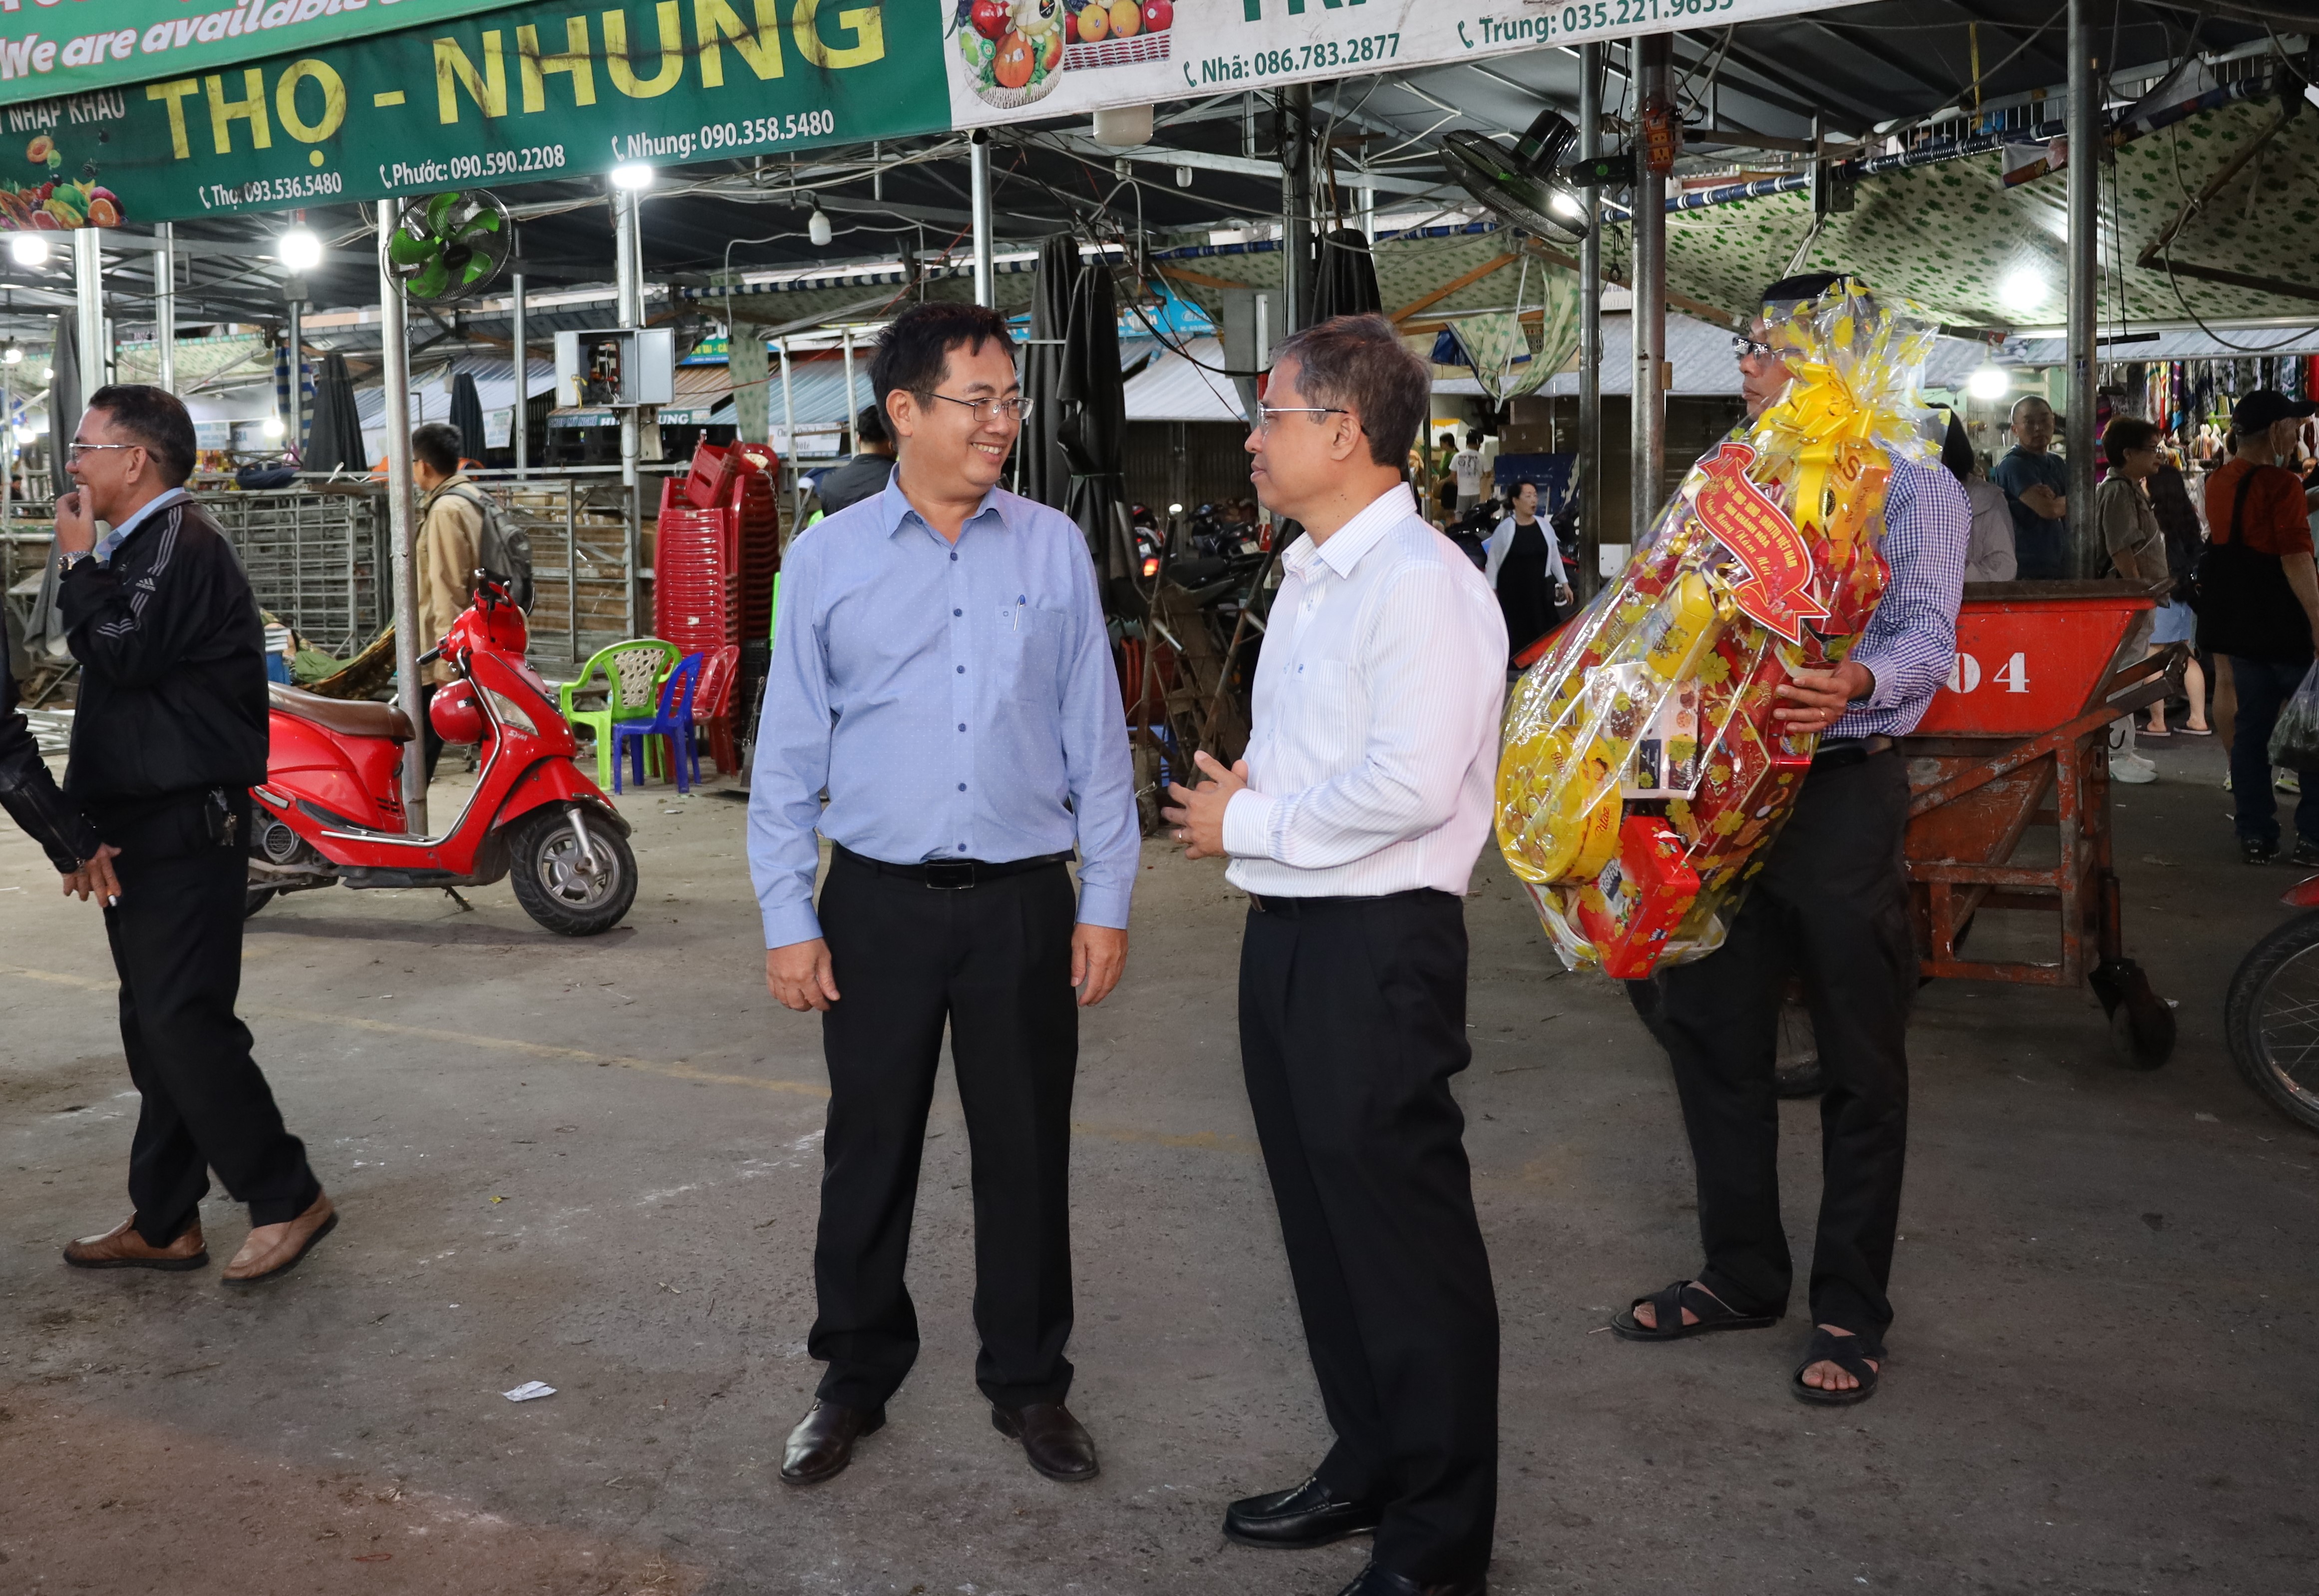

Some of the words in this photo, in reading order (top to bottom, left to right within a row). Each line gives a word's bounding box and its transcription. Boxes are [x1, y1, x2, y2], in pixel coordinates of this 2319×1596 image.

[1479, 15, 1557, 44] Trung:
[0, 33, 57, 80] We
[61, 27, 138, 67] are
[1202, 54, 1249, 83] Nhã:
[1255, 33, 1400, 75] 086.783.2877
[145, 58, 346, 168] THỌ
[432, 0, 886, 125] NHUNG
[627, 132, 697, 159] Nhung:
[700, 109, 834, 150] 090.358.5480
[392, 159, 448, 186] Phước:
[450, 144, 566, 180] 090.590.2208
[244, 172, 342, 203] 093.536.5480
[1733, 511, 1758, 534] KHÁNH
[1754, 530, 1771, 549] HÒA
[1776, 534, 1792, 551] VIỆT
[1735, 529, 1757, 555] Năm
[1754, 556, 1773, 576] Mới
[1783, 549, 1798, 568] NAM
